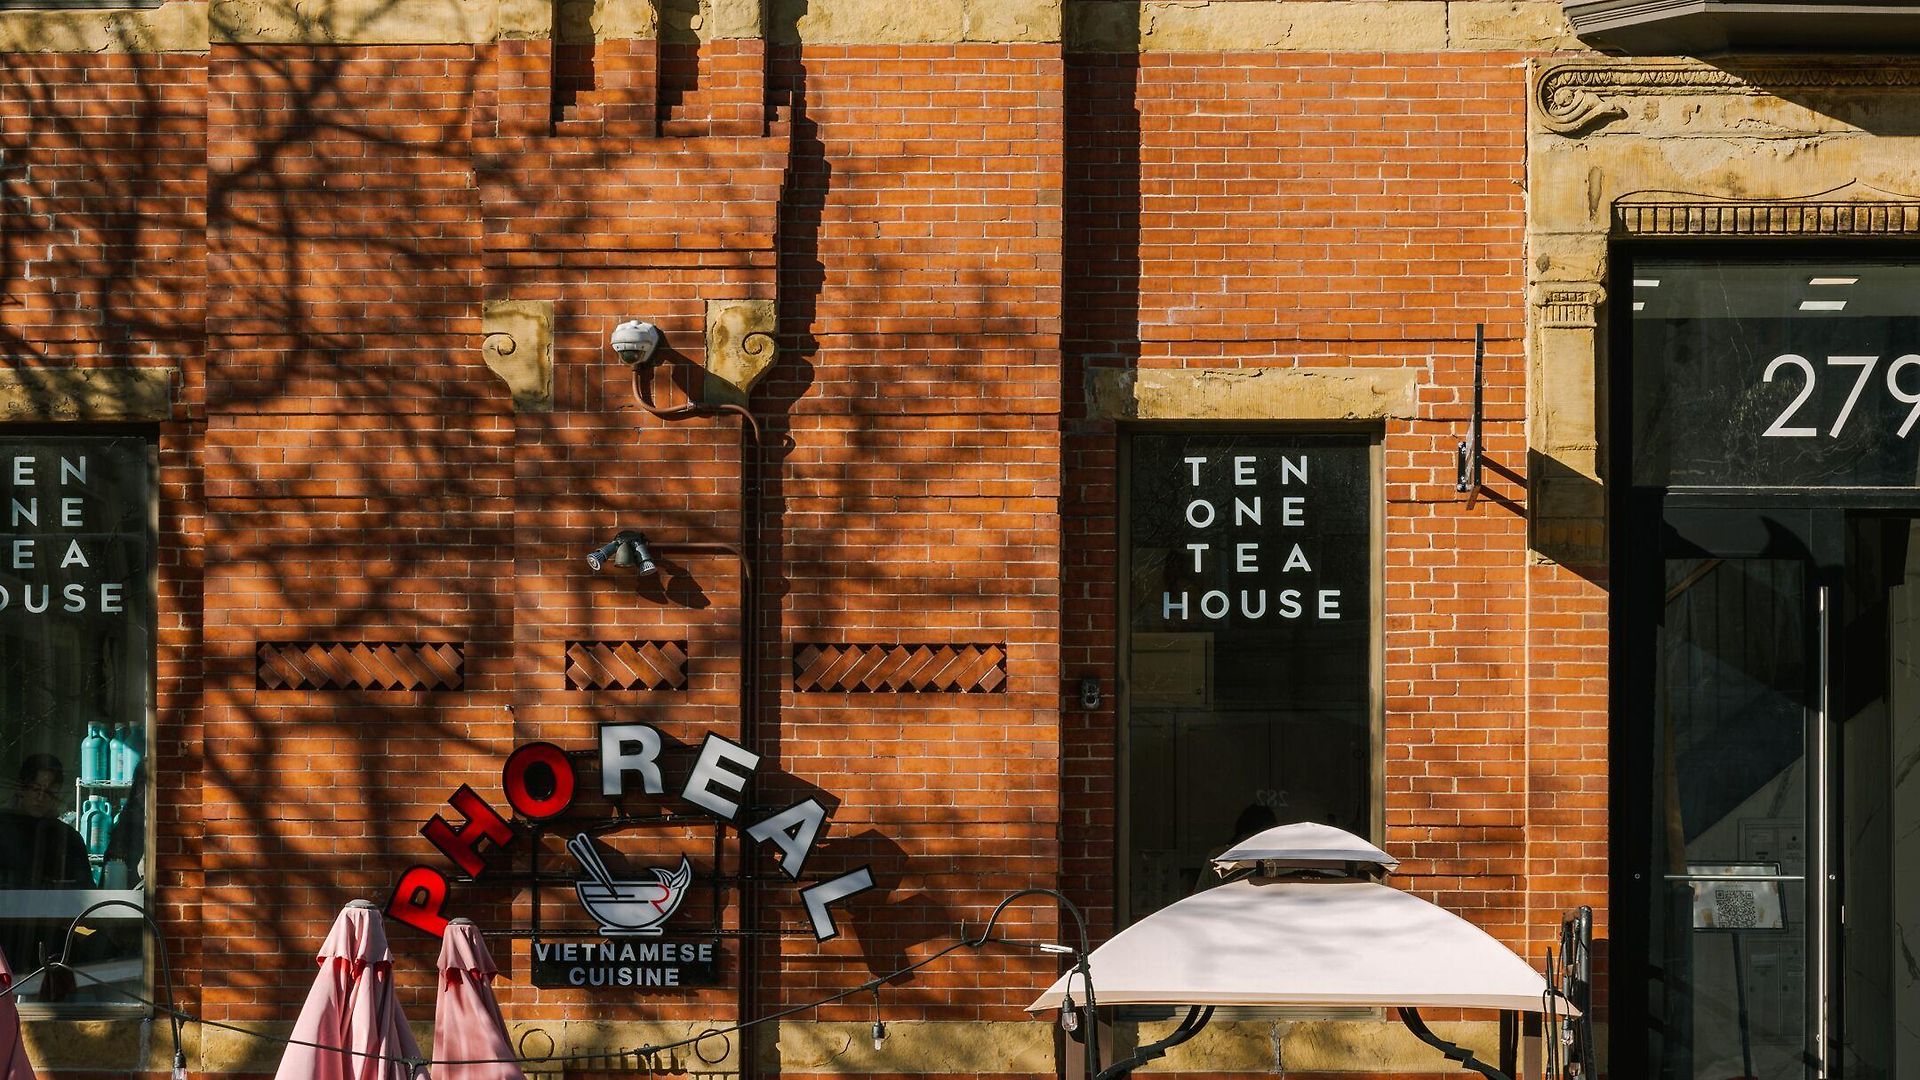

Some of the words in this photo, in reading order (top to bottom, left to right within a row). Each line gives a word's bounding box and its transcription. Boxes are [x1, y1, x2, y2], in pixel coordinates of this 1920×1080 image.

[1761, 353, 1920, 439] 279
[1184, 455, 1308, 486] TEN
[1186, 496, 1305, 528] ONE
[1186, 543, 1312, 573] TEA
[1163, 589, 1341, 620] HOUSE
[384, 741, 577, 939] PHO
[598, 722, 877, 943] REAL
[534, 943, 713, 962] VIETNAMESE
[568, 966, 680, 986] CUISINE
